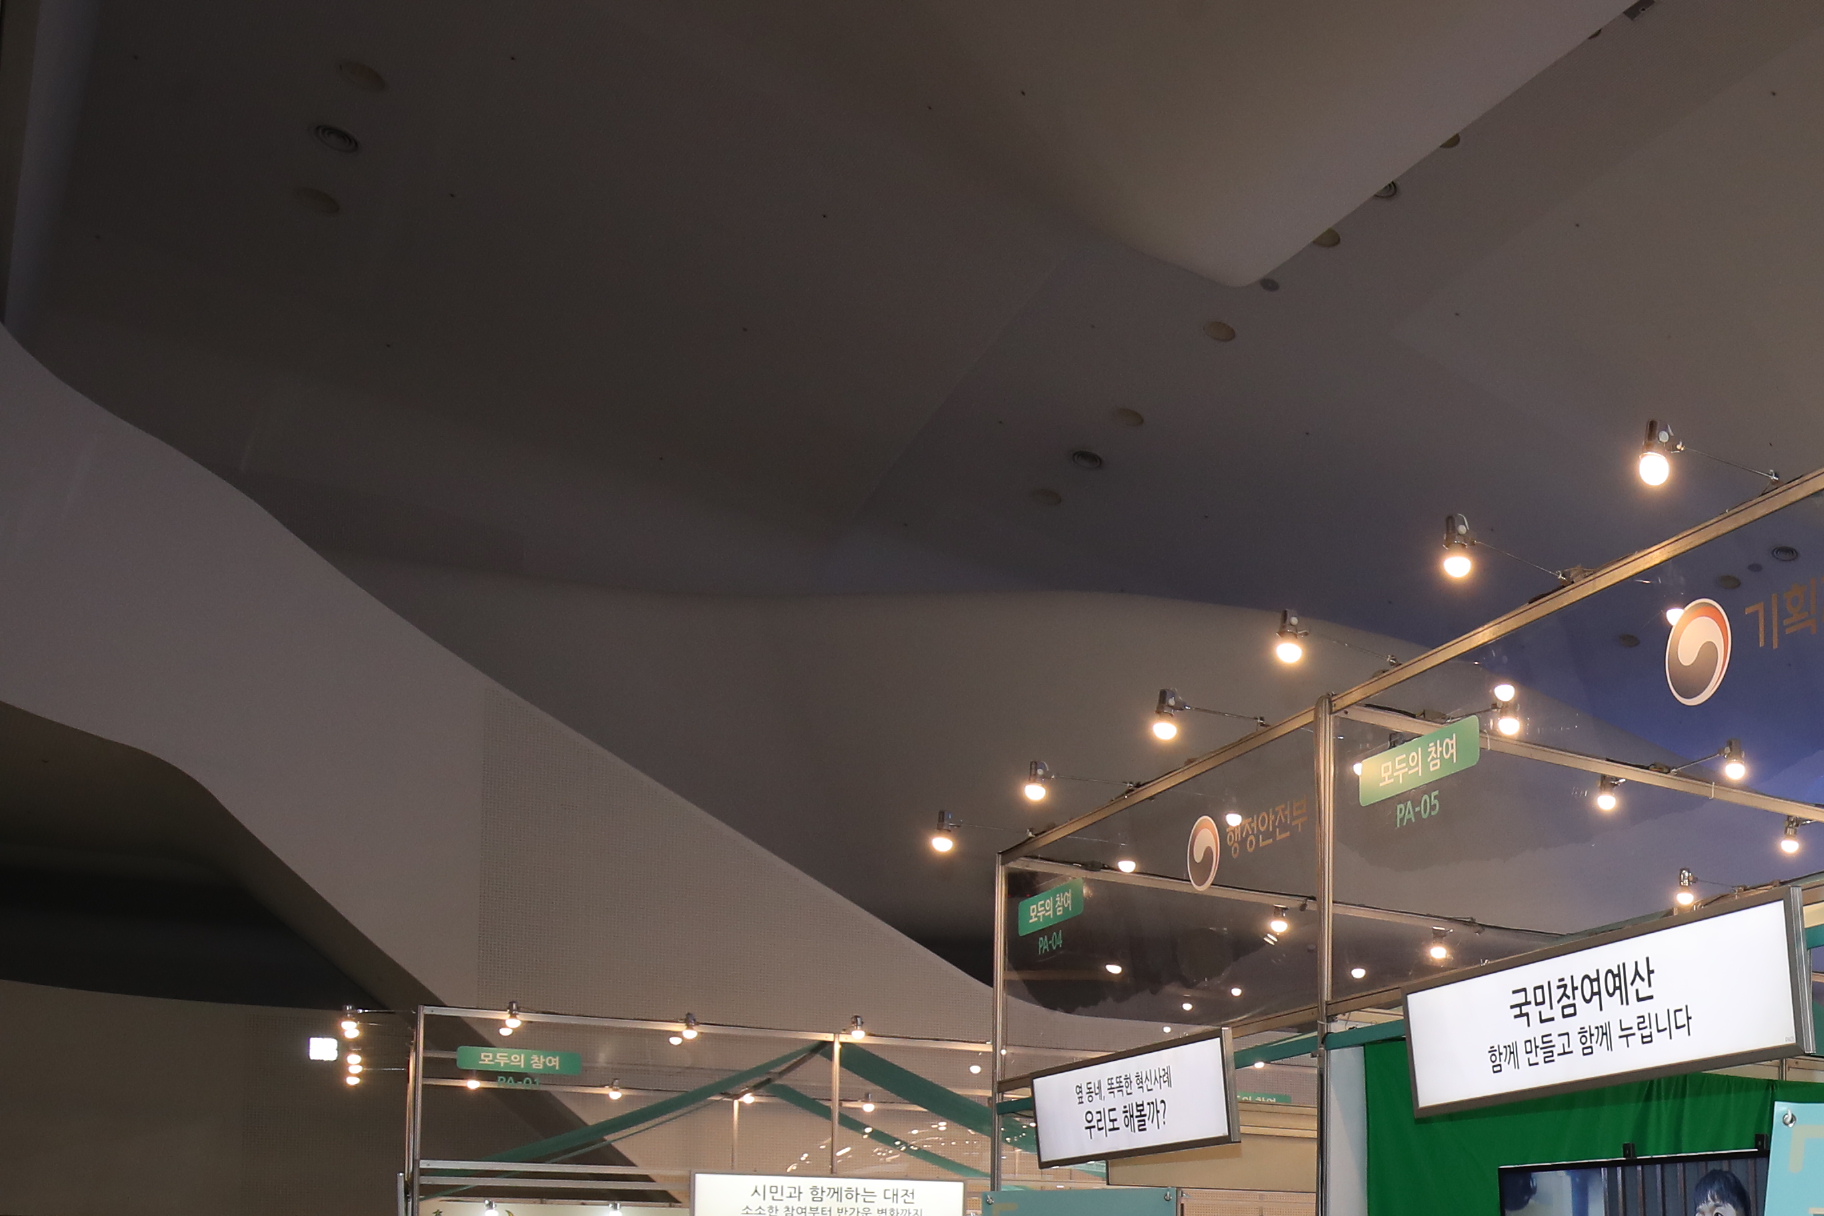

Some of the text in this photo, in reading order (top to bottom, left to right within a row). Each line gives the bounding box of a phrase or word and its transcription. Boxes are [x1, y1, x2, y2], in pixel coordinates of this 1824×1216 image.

[1379, 734, 1457, 786] 모두의 참여
[1226, 794, 1308, 858] 행정안전부
[1396, 790, 1440, 828] PA-05
[1029, 891, 1072, 922] 모두의 참여
[1038, 930, 1063, 954] PA-04
[1510, 956, 1655, 1028] 국민참여예산
[1488, 1004, 1693, 1074] 함께 만들고 함께 누립니다
[479, 1052, 559, 1070] 모두의 참여
[1075, 1065, 1172, 1105] 옆 동네, 똑똑한 혁신사례
[1084, 1100, 1167, 1139] 우리도 해볼까?
[751, 1184, 915, 1204] 시민과 함께하는 대전
